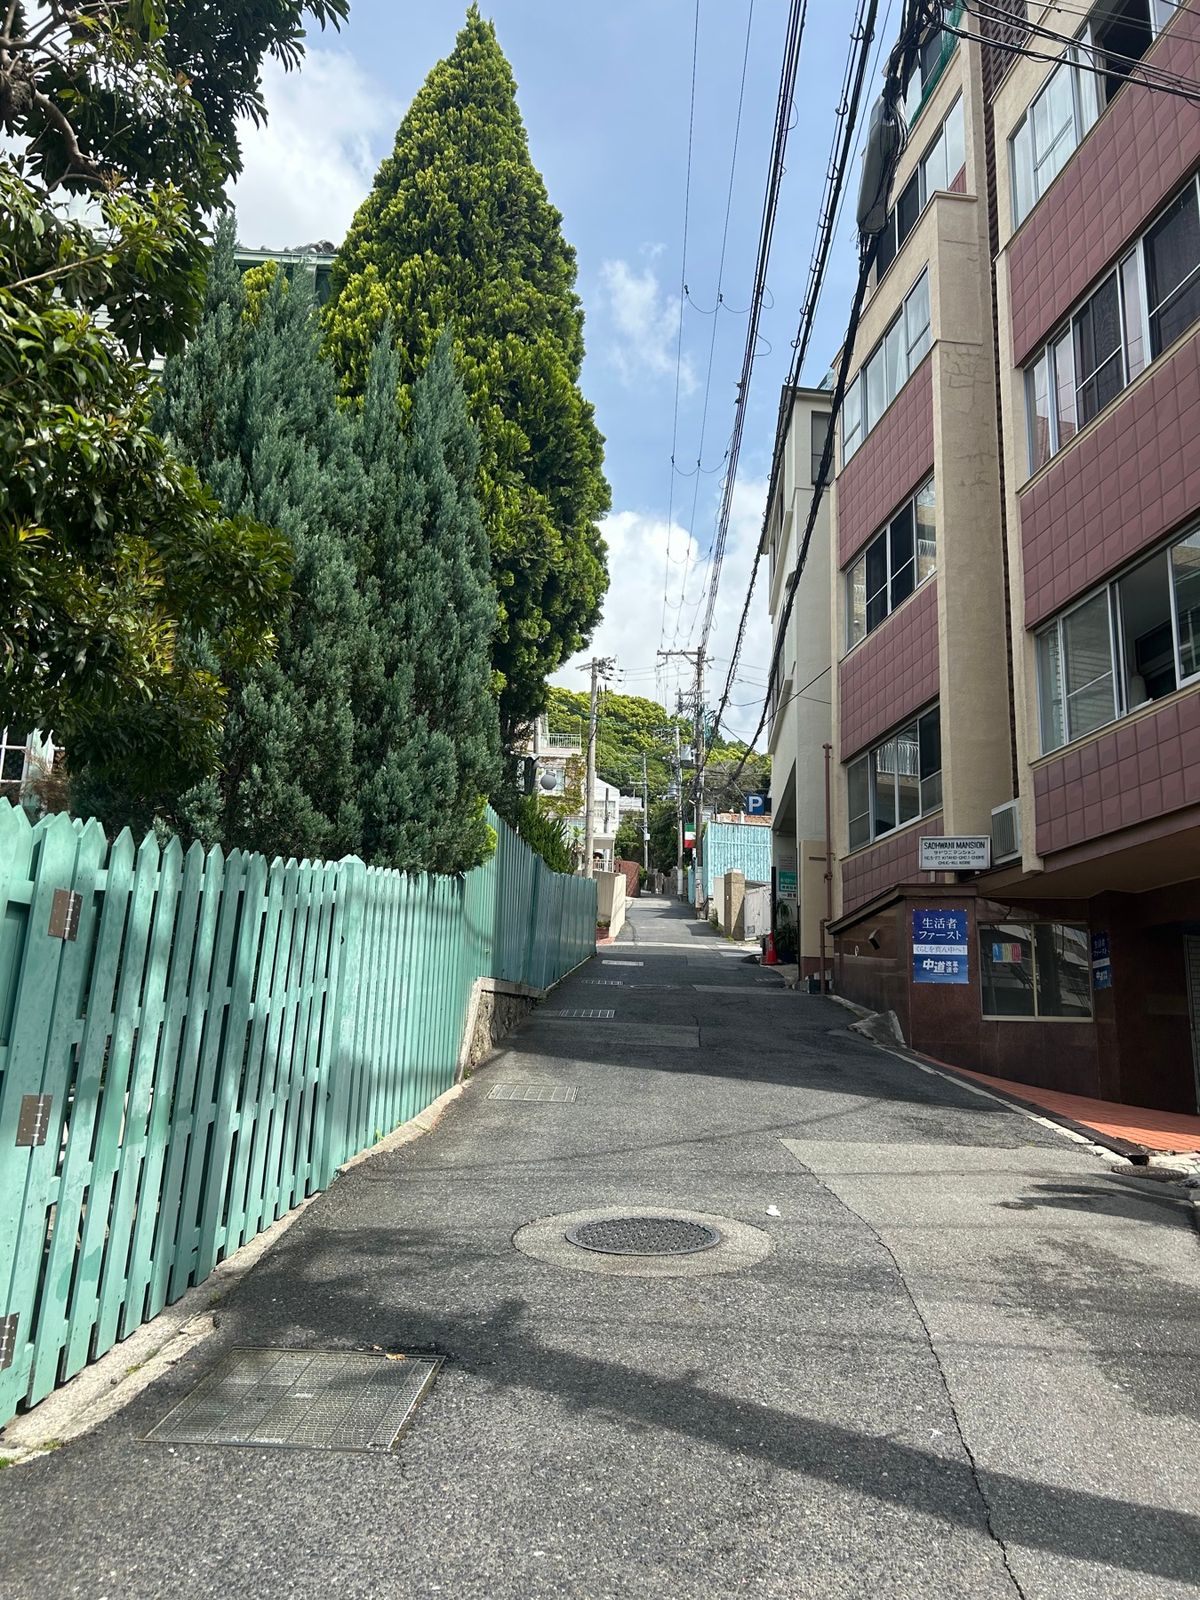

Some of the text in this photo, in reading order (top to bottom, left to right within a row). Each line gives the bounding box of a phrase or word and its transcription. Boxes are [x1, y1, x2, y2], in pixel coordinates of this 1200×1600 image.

[748, 796, 763, 812] P
[956, 841, 986, 849] MANSION
[922, 918, 958, 930] 生活者
[918, 930, 962, 940] ファースト
